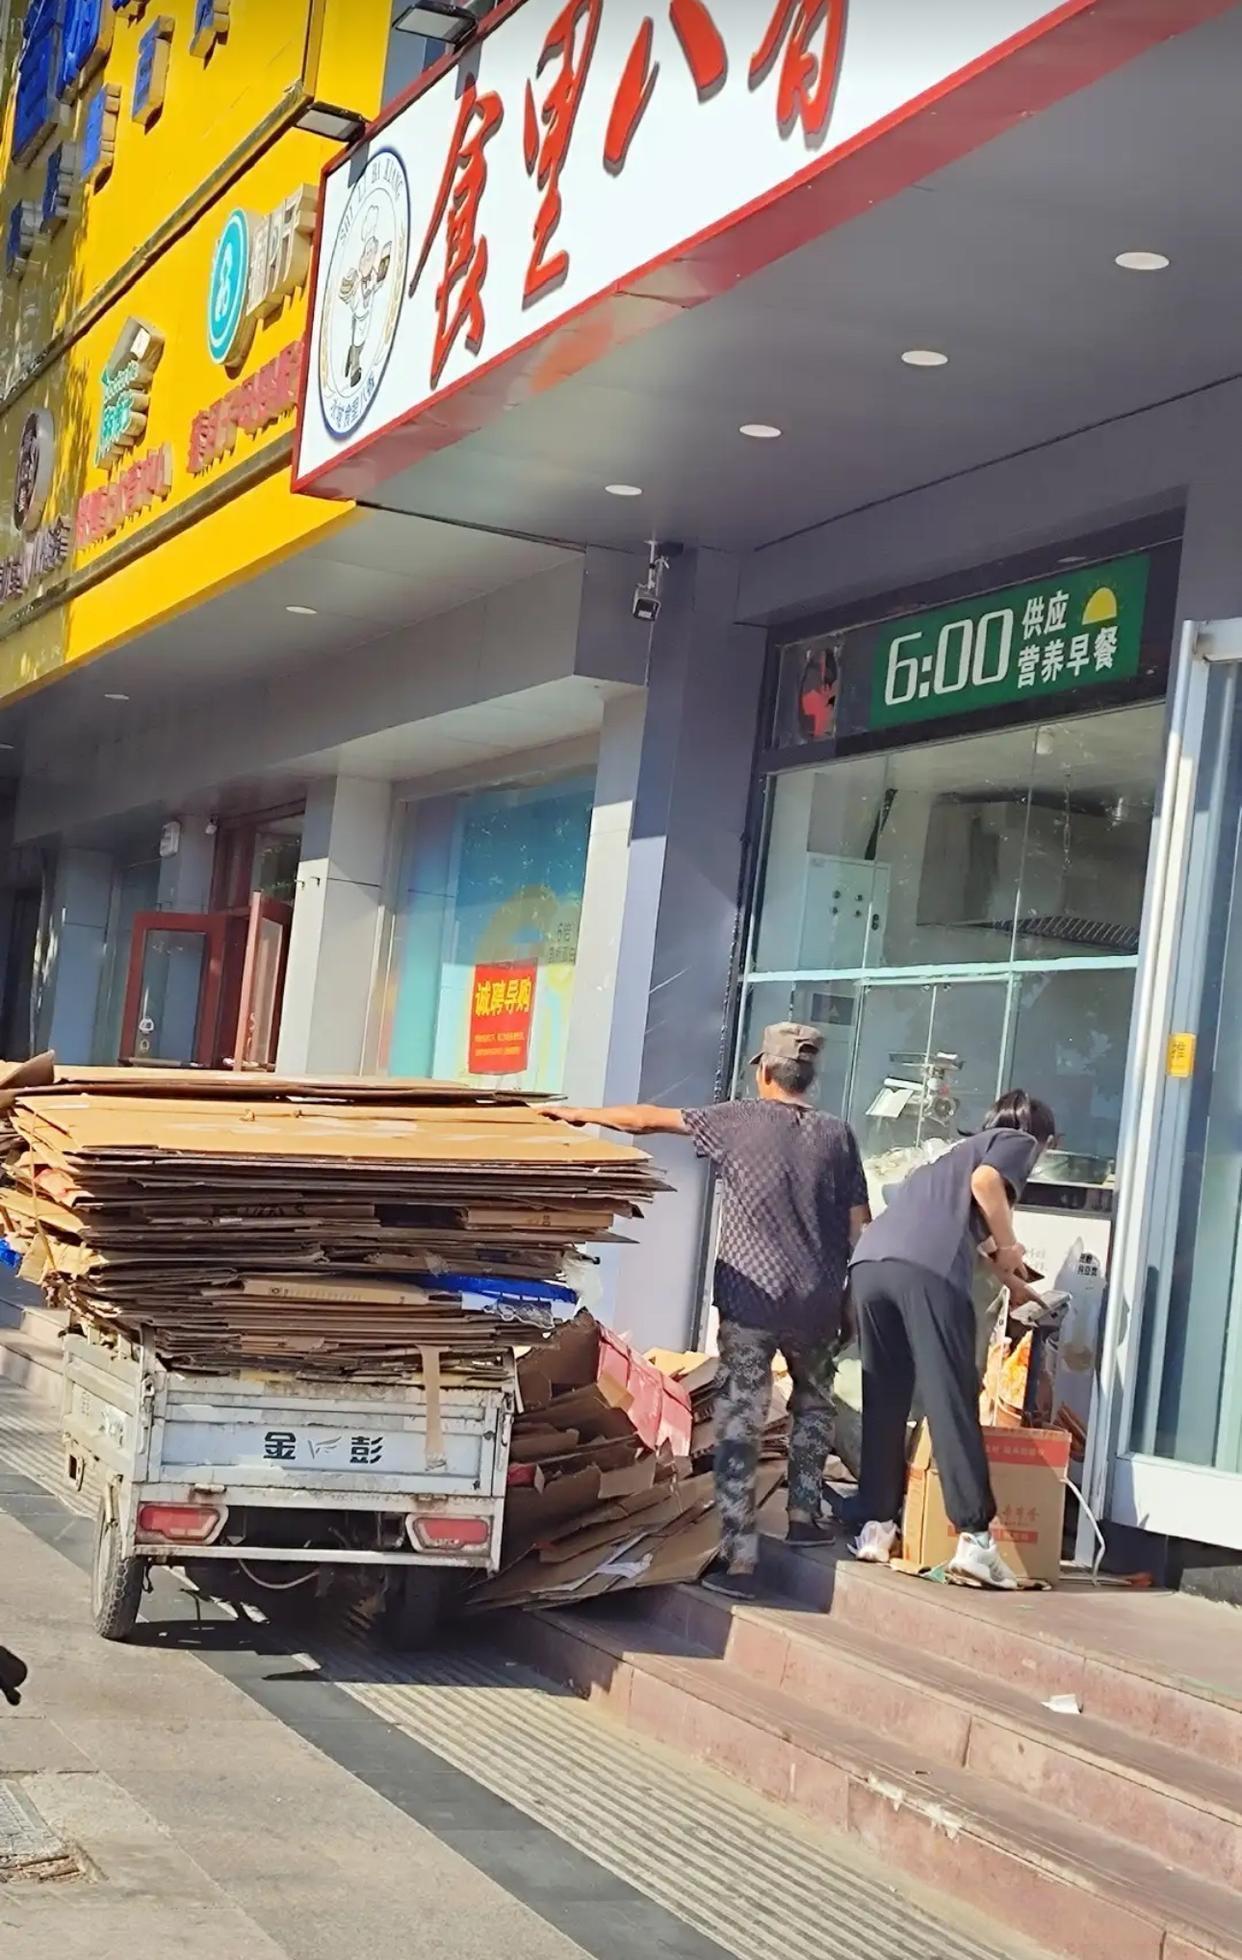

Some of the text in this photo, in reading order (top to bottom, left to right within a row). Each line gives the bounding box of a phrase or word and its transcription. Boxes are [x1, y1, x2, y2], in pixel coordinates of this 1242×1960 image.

[885, 589, 1070, 706] 6:00 供应
[1017, 625, 1119, 689] 营养早餐
[263, 1431, 383, 1464] 金彭
